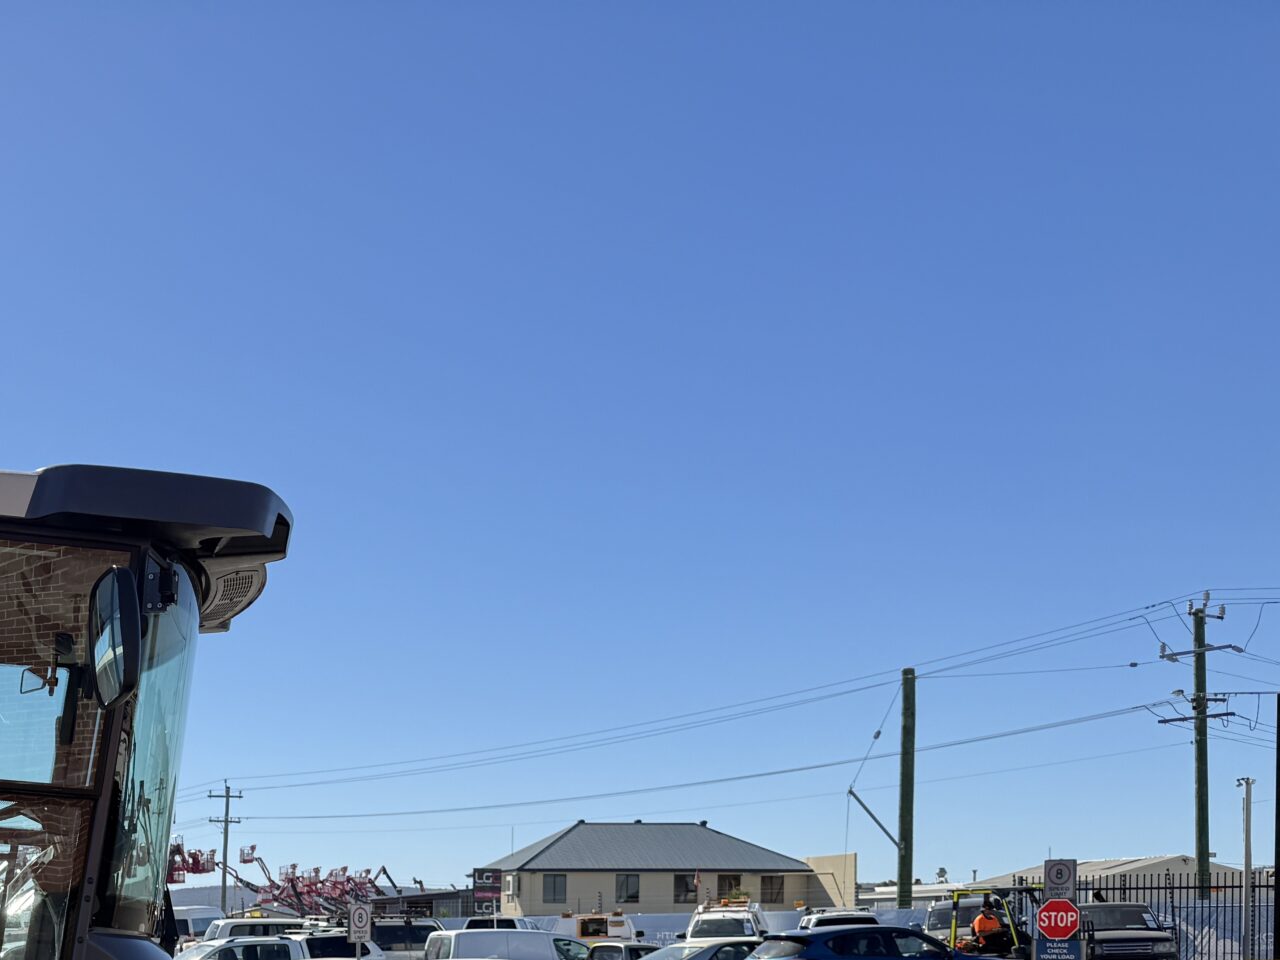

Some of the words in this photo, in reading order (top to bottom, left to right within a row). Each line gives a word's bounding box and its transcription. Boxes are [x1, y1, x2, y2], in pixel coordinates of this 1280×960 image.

[1056, 868, 1063, 880] 8
[358, 912, 363, 923] 8
[1040, 911, 1076, 927] STOP
